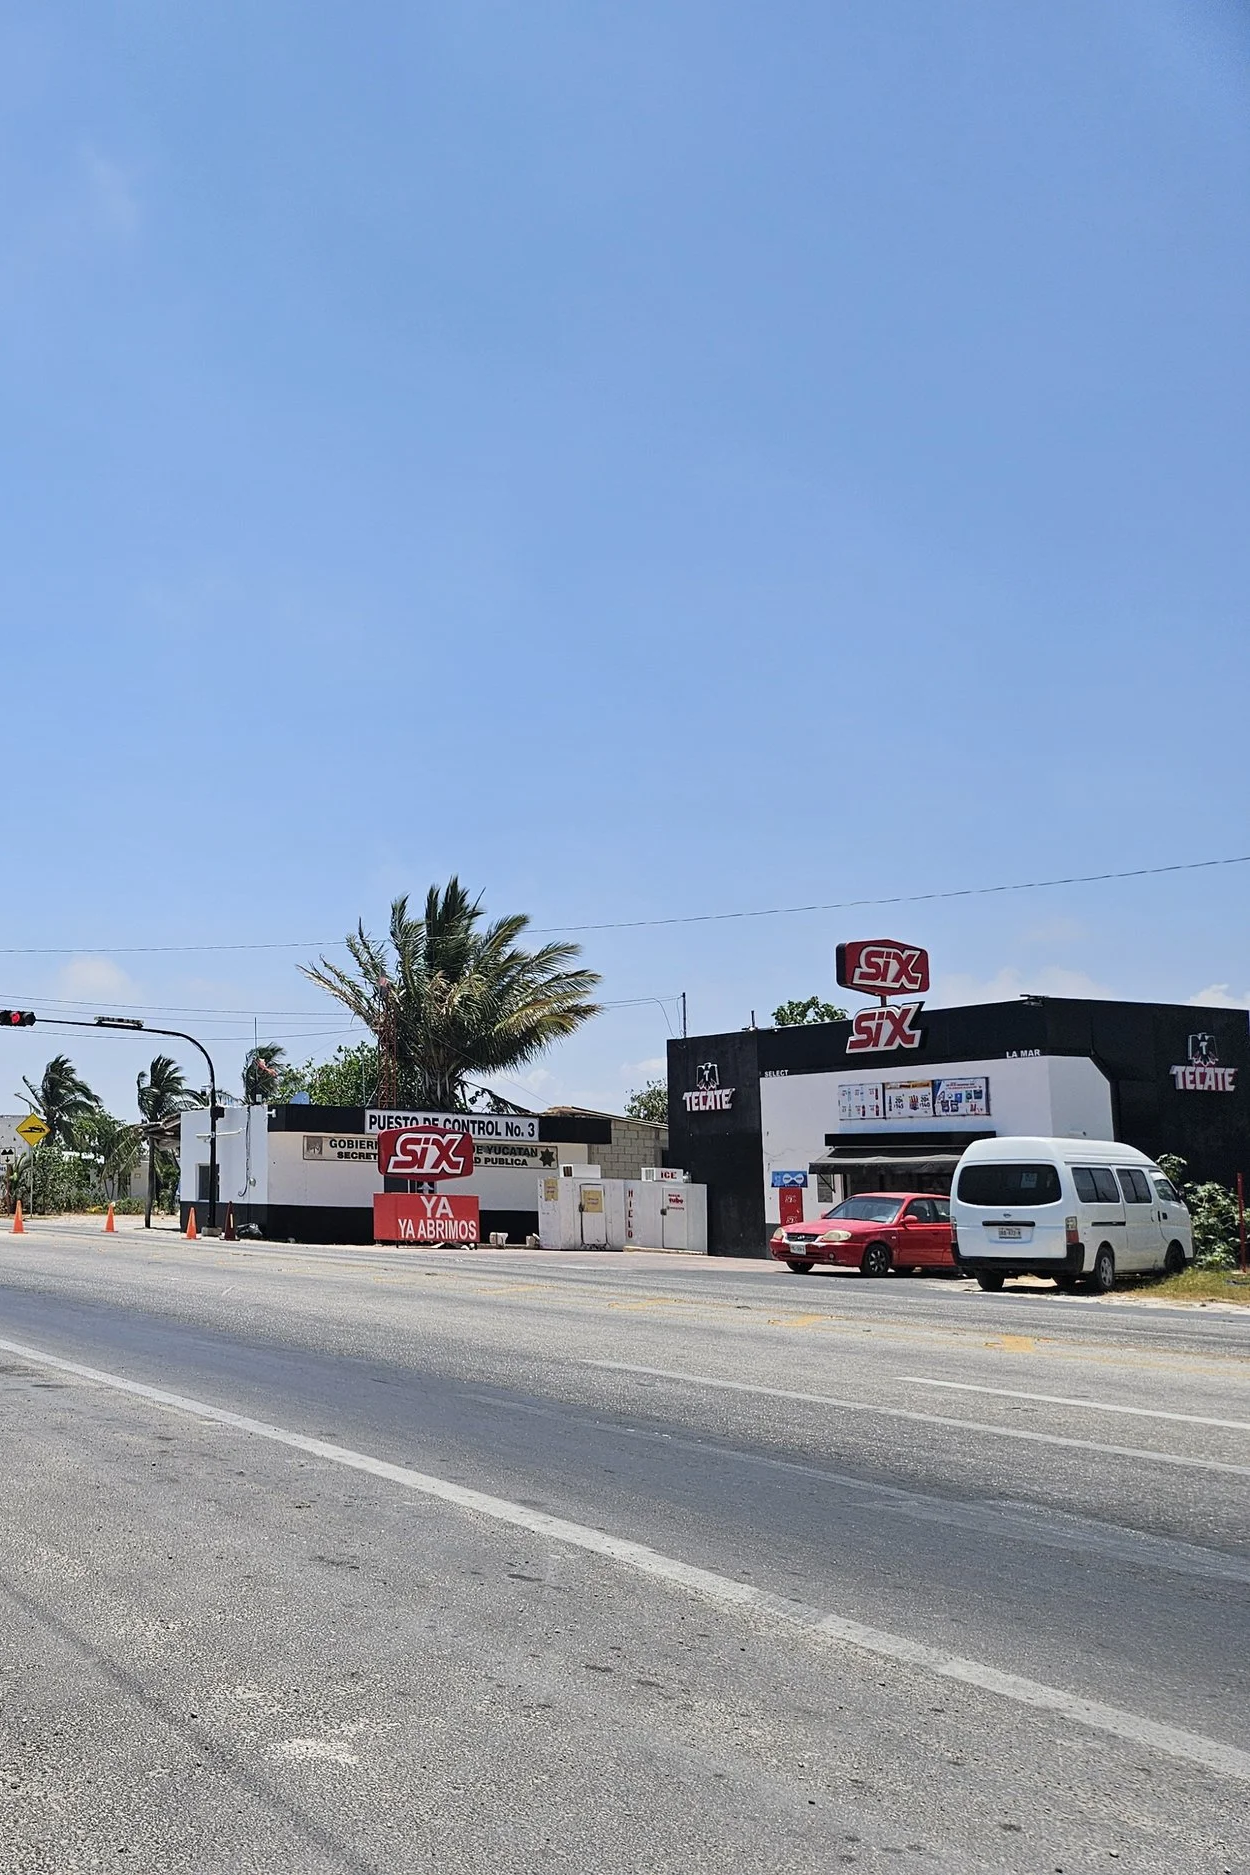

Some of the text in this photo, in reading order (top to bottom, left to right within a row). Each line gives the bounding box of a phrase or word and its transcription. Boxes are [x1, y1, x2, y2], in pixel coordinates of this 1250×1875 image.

[1006, 1049, 1040, 1059] LA MAR
[764, 1069, 789, 1078] SELECT
[1169, 1065, 1238, 1091] TECATE
[682, 1087, 735, 1112] TECATE
[369, 1114, 419, 1130] PUESTO
[443, 1118, 502, 1136] CONTROL
[505, 1121, 524, 1137] No.
[528, 1122, 535, 1138] 3
[329, 1139, 378, 1149] GOBIER
[486, 1146, 538, 1157] YUCATAN
[484, 1157, 528, 1167] PUBLICA
[660, 1171, 677, 1180] ICE
[420, 1195, 455, 1218] YA
[397, 1218, 477, 1240] YA ABRIMOS
